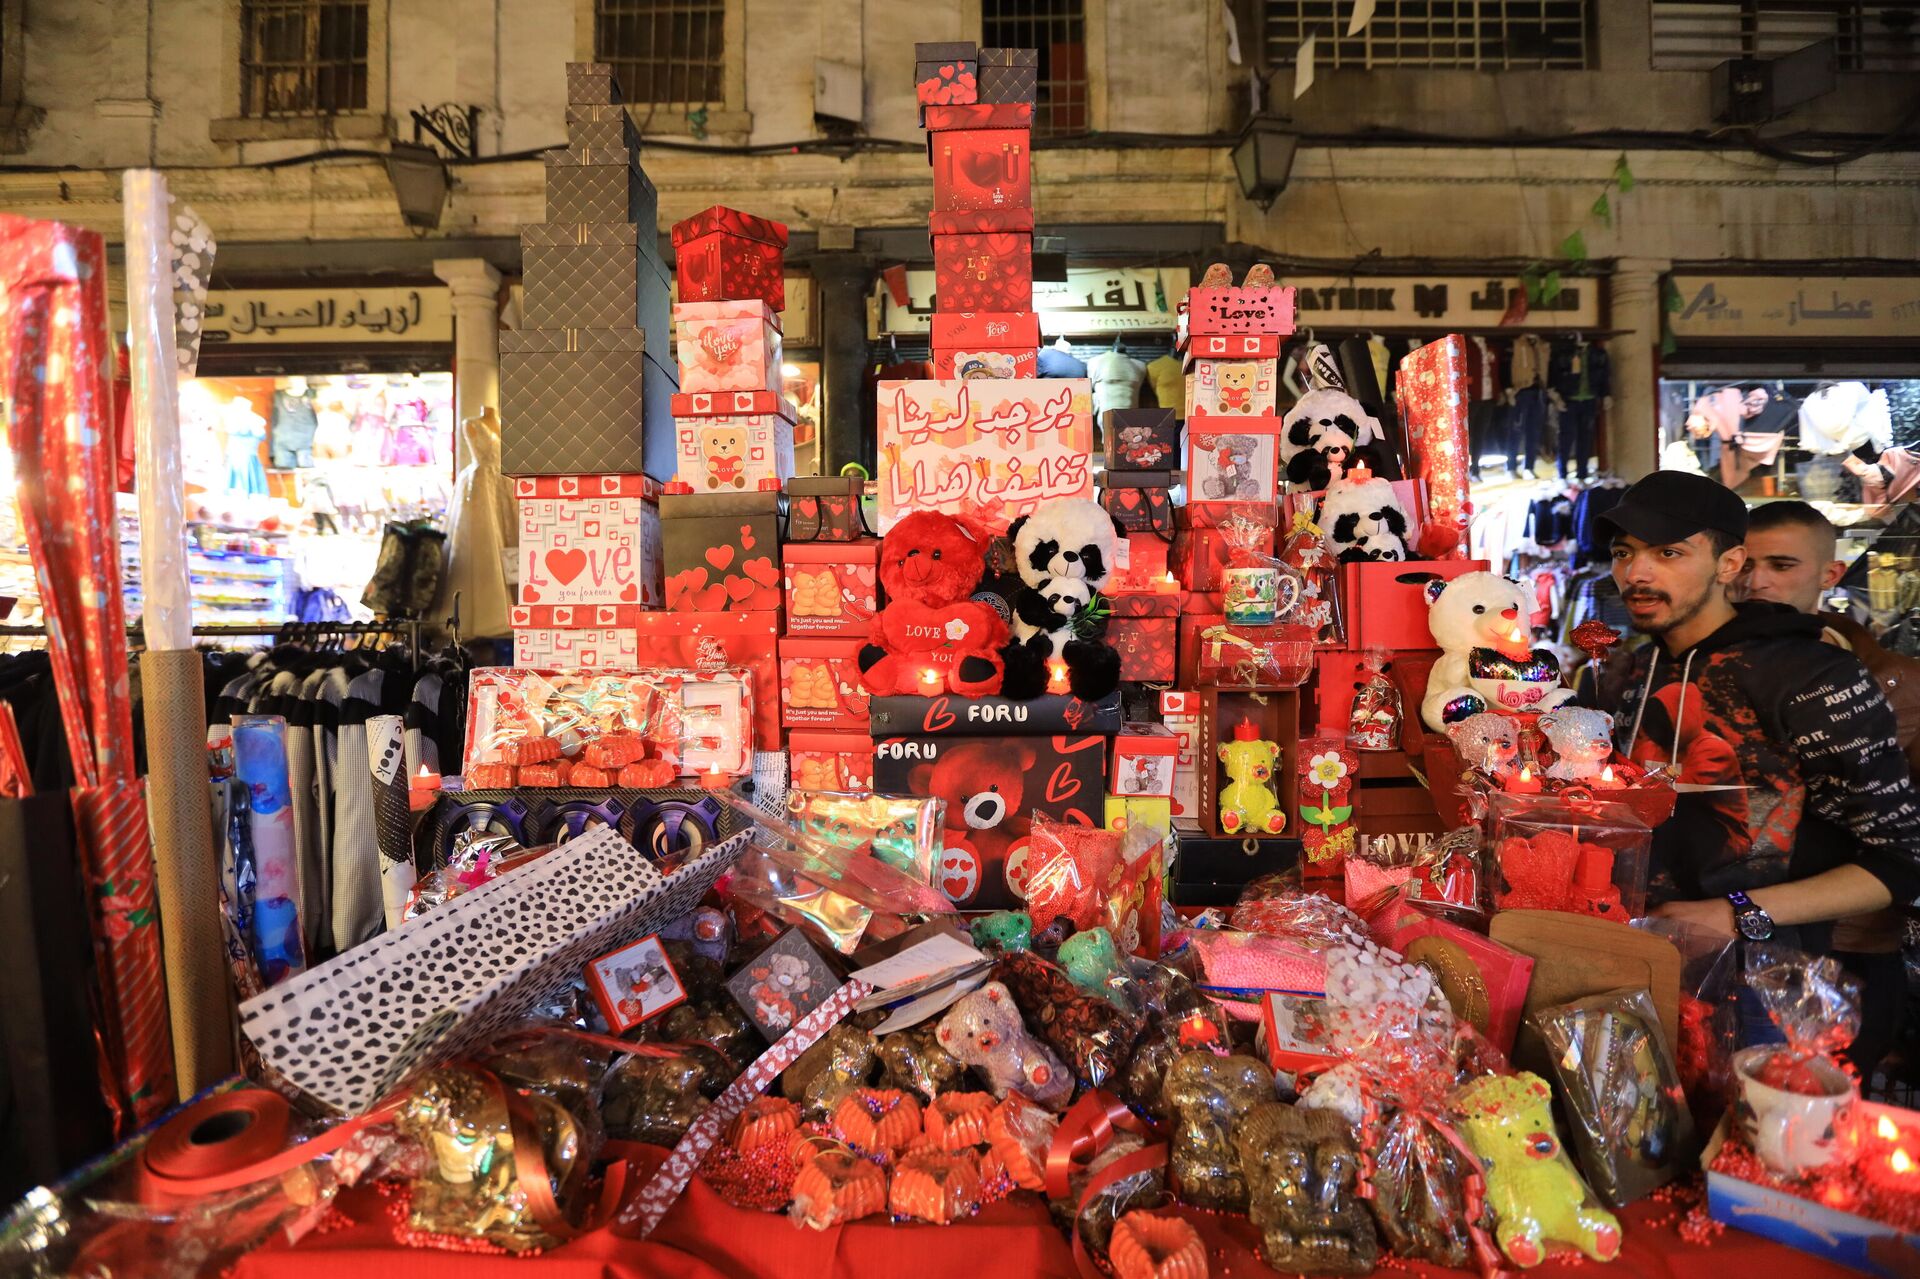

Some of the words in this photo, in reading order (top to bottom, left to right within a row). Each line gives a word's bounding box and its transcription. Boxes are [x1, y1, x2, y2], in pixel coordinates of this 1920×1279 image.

[1220, 307, 1266, 319] Love
[895, 386, 969, 445] لدينا
[973, 387, 1074, 444] يوجد
[890, 460, 971, 521] هدايا
[977, 454, 1088, 515] تغليف
[558, 590, 576, 601] you
[580, 586, 613, 601] forever
[906, 624, 941, 638] LOVE
[1795, 683, 1836, 702] Hoodie
[1823, 688, 1852, 707] JUST
[968, 704, 1012, 723] FOR
[1829, 710, 1852, 723] Boy
[1810, 730, 1830, 742] IT.
[1828, 736, 1871, 754] Hoodie
[877, 742, 920, 760] FOR
